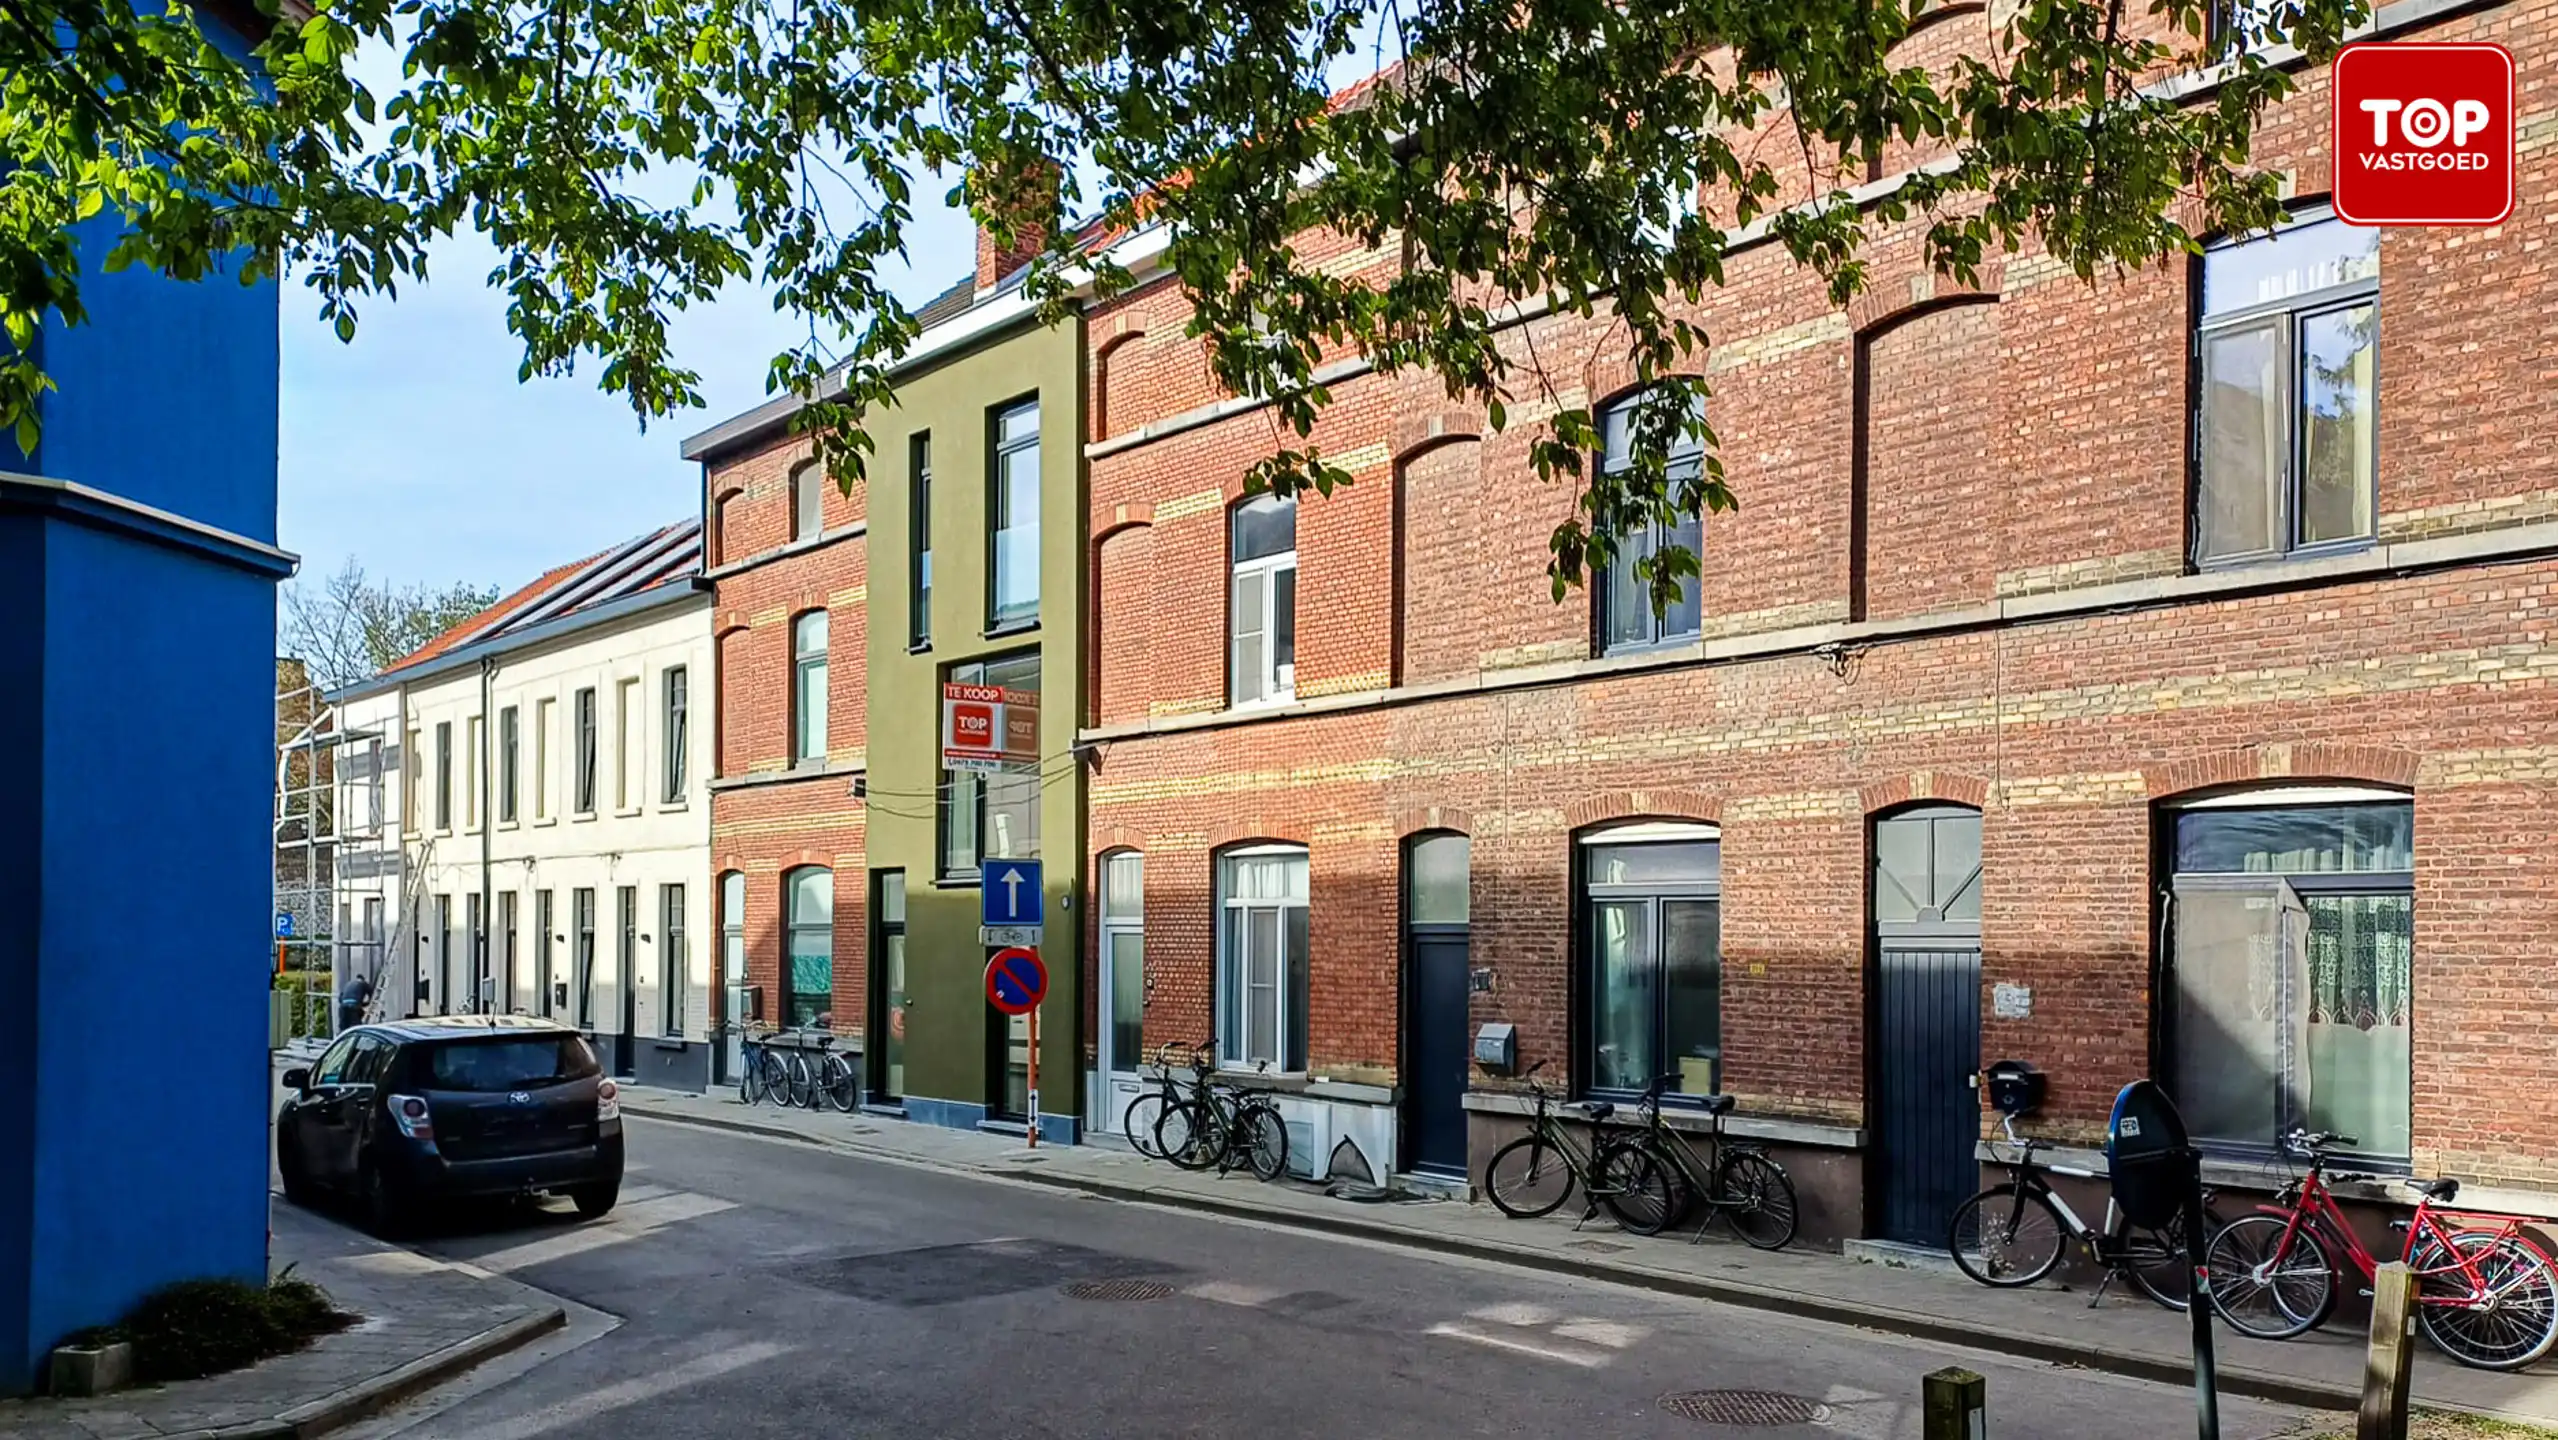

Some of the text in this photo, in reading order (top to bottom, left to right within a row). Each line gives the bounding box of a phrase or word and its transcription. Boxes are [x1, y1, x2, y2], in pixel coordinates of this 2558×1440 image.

[948, 687, 961, 698] TE
[963, 687, 999, 700] KOOP
[958, 716, 988, 729] TOP
[277, 917, 288, 931] P
